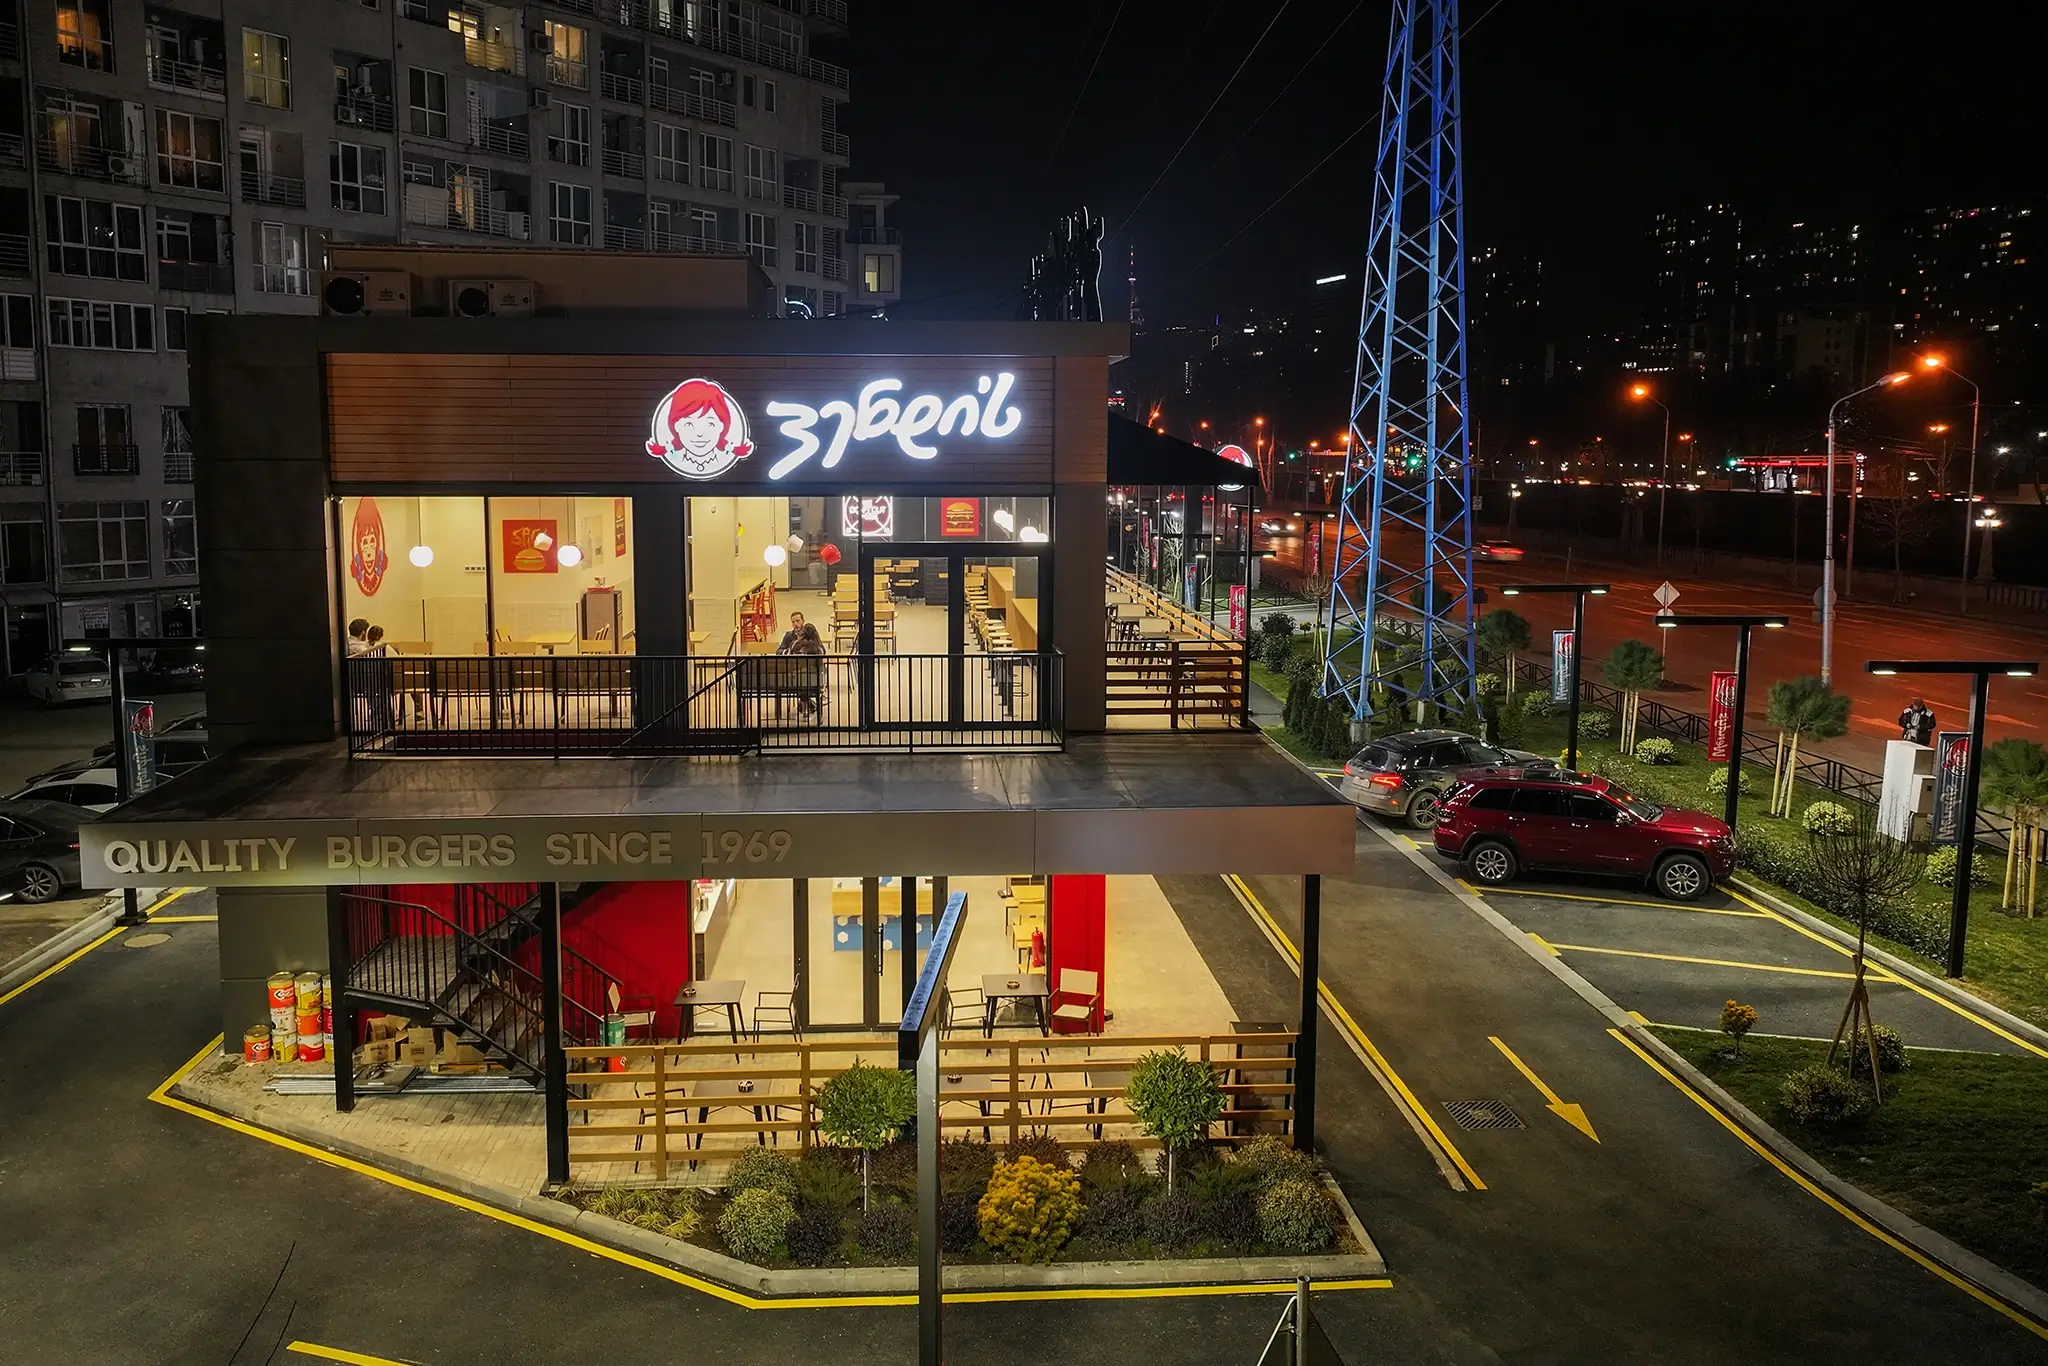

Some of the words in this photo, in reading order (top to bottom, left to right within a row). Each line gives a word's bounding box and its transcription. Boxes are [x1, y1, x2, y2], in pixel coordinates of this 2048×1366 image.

[103, 837, 296, 873] QUALITY
[326, 833, 516, 869] BURGERS
[545, 831, 672, 865] SINCE
[701, 829, 793, 864] 1969
